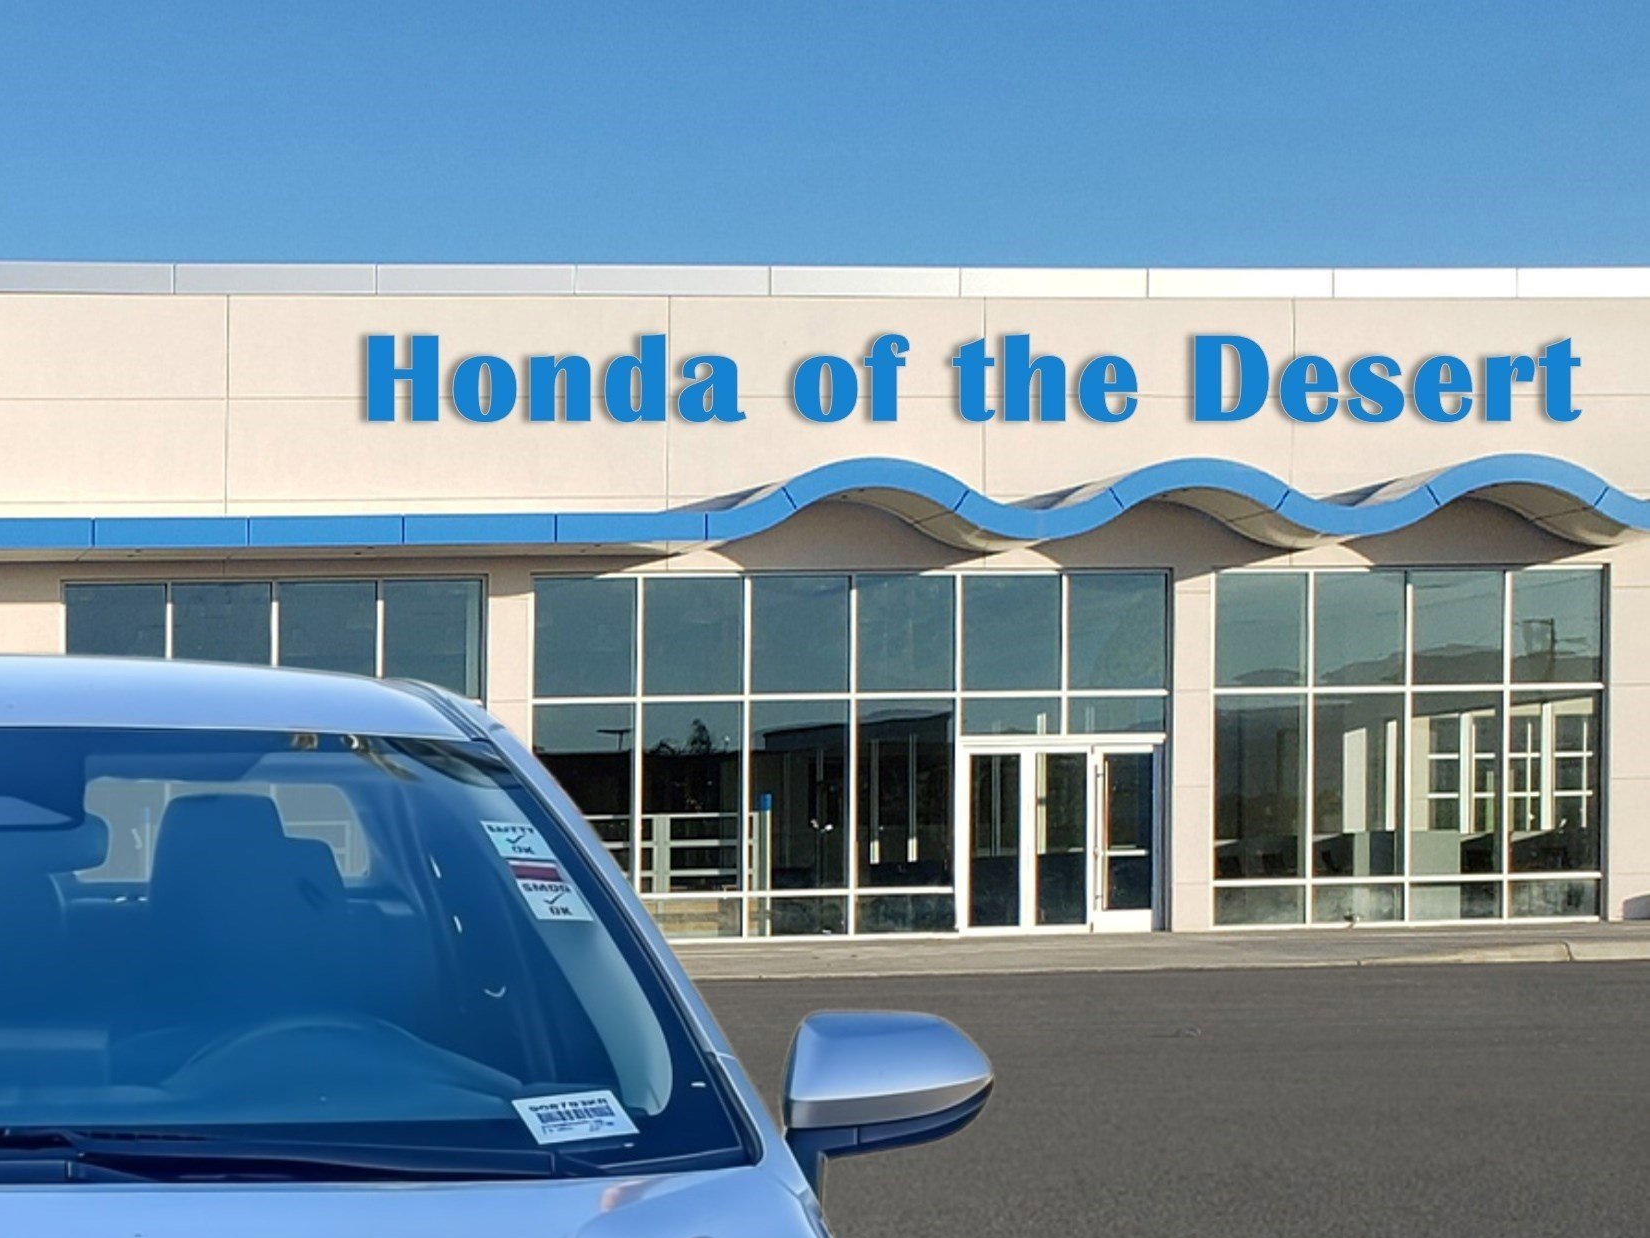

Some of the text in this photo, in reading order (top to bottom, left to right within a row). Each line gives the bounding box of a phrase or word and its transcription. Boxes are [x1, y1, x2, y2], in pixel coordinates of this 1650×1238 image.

[366, 332, 1583, 424] Honda of the Desert
